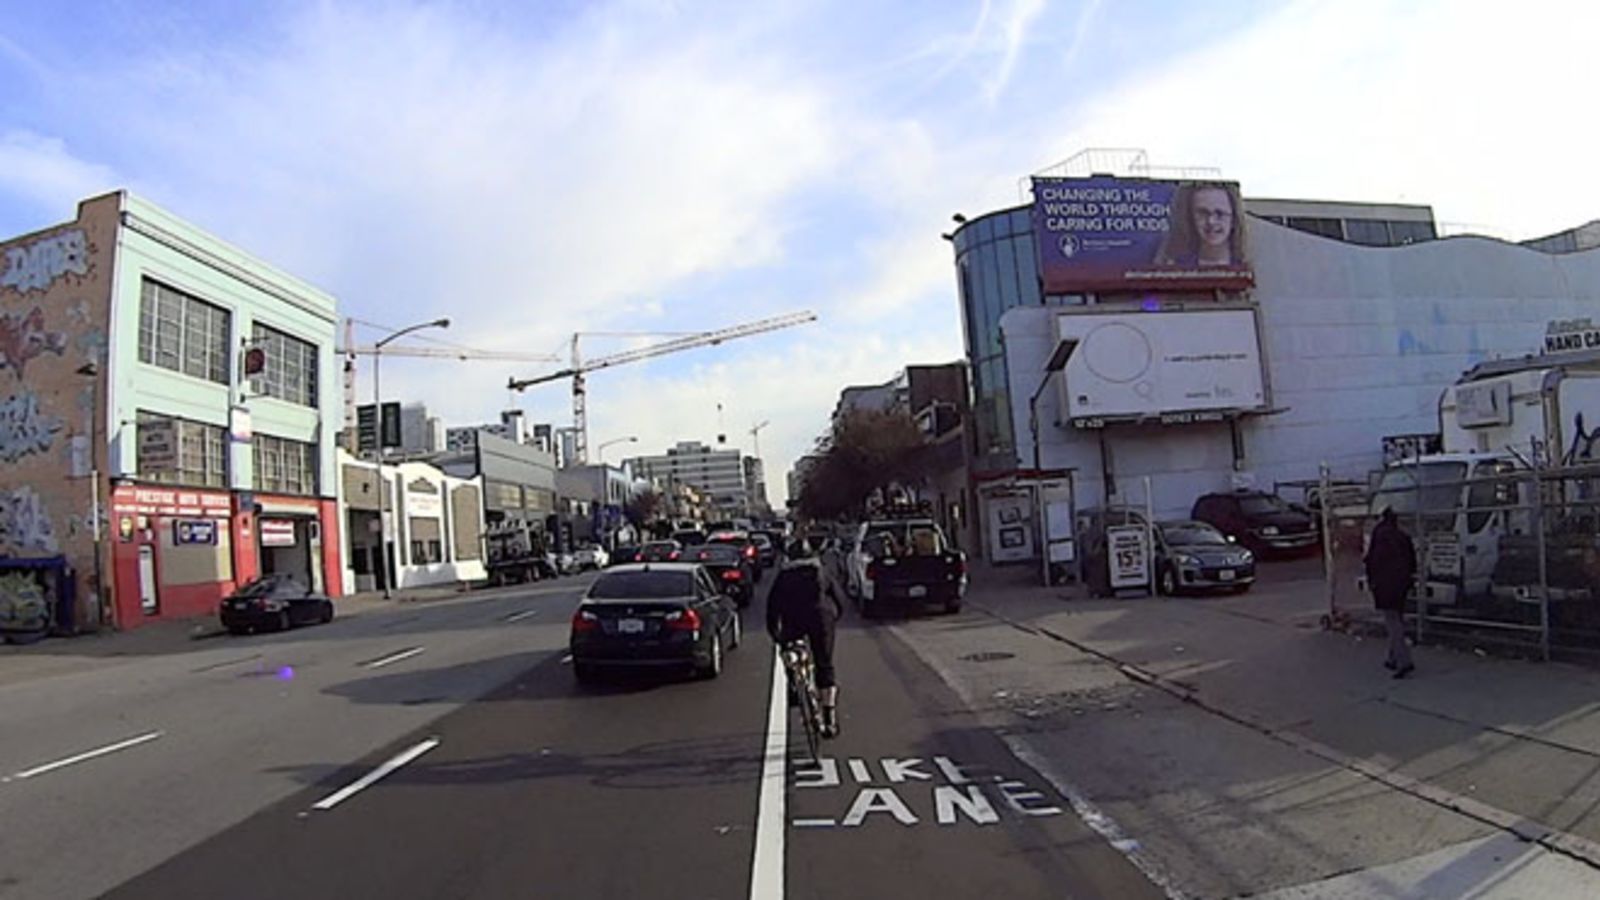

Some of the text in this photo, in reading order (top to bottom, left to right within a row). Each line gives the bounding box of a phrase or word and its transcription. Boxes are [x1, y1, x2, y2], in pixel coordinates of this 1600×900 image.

[1042, 188, 1151, 201] CHANGING THE
[1043, 202, 1171, 217] WORLD THROUGH
[1046, 217, 1171, 232] CARING FOR KIDS
[1545, 334, 1582, 352] HAND
